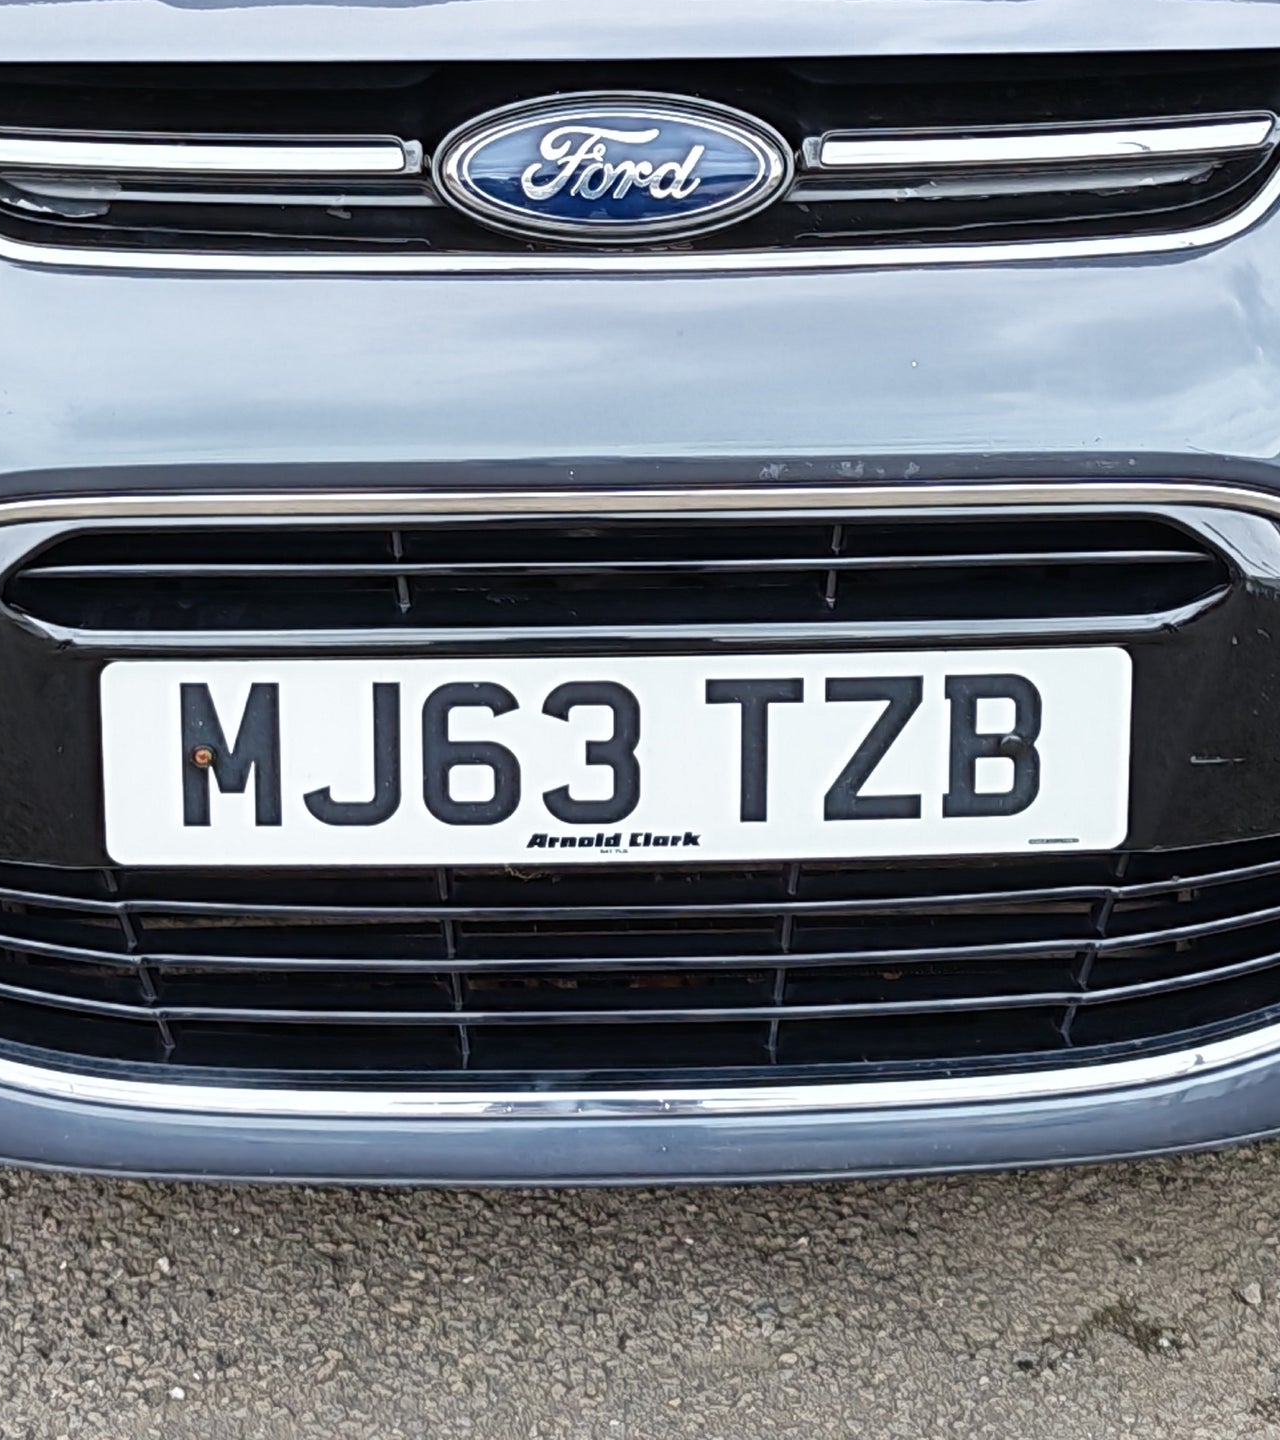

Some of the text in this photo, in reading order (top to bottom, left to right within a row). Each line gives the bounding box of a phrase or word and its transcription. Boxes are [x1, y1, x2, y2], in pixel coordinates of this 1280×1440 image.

[520, 124, 707, 201] Ford
[178, 672, 1044, 828] MJ63 TZB
[526, 831, 701, 849] Arnold Clark
